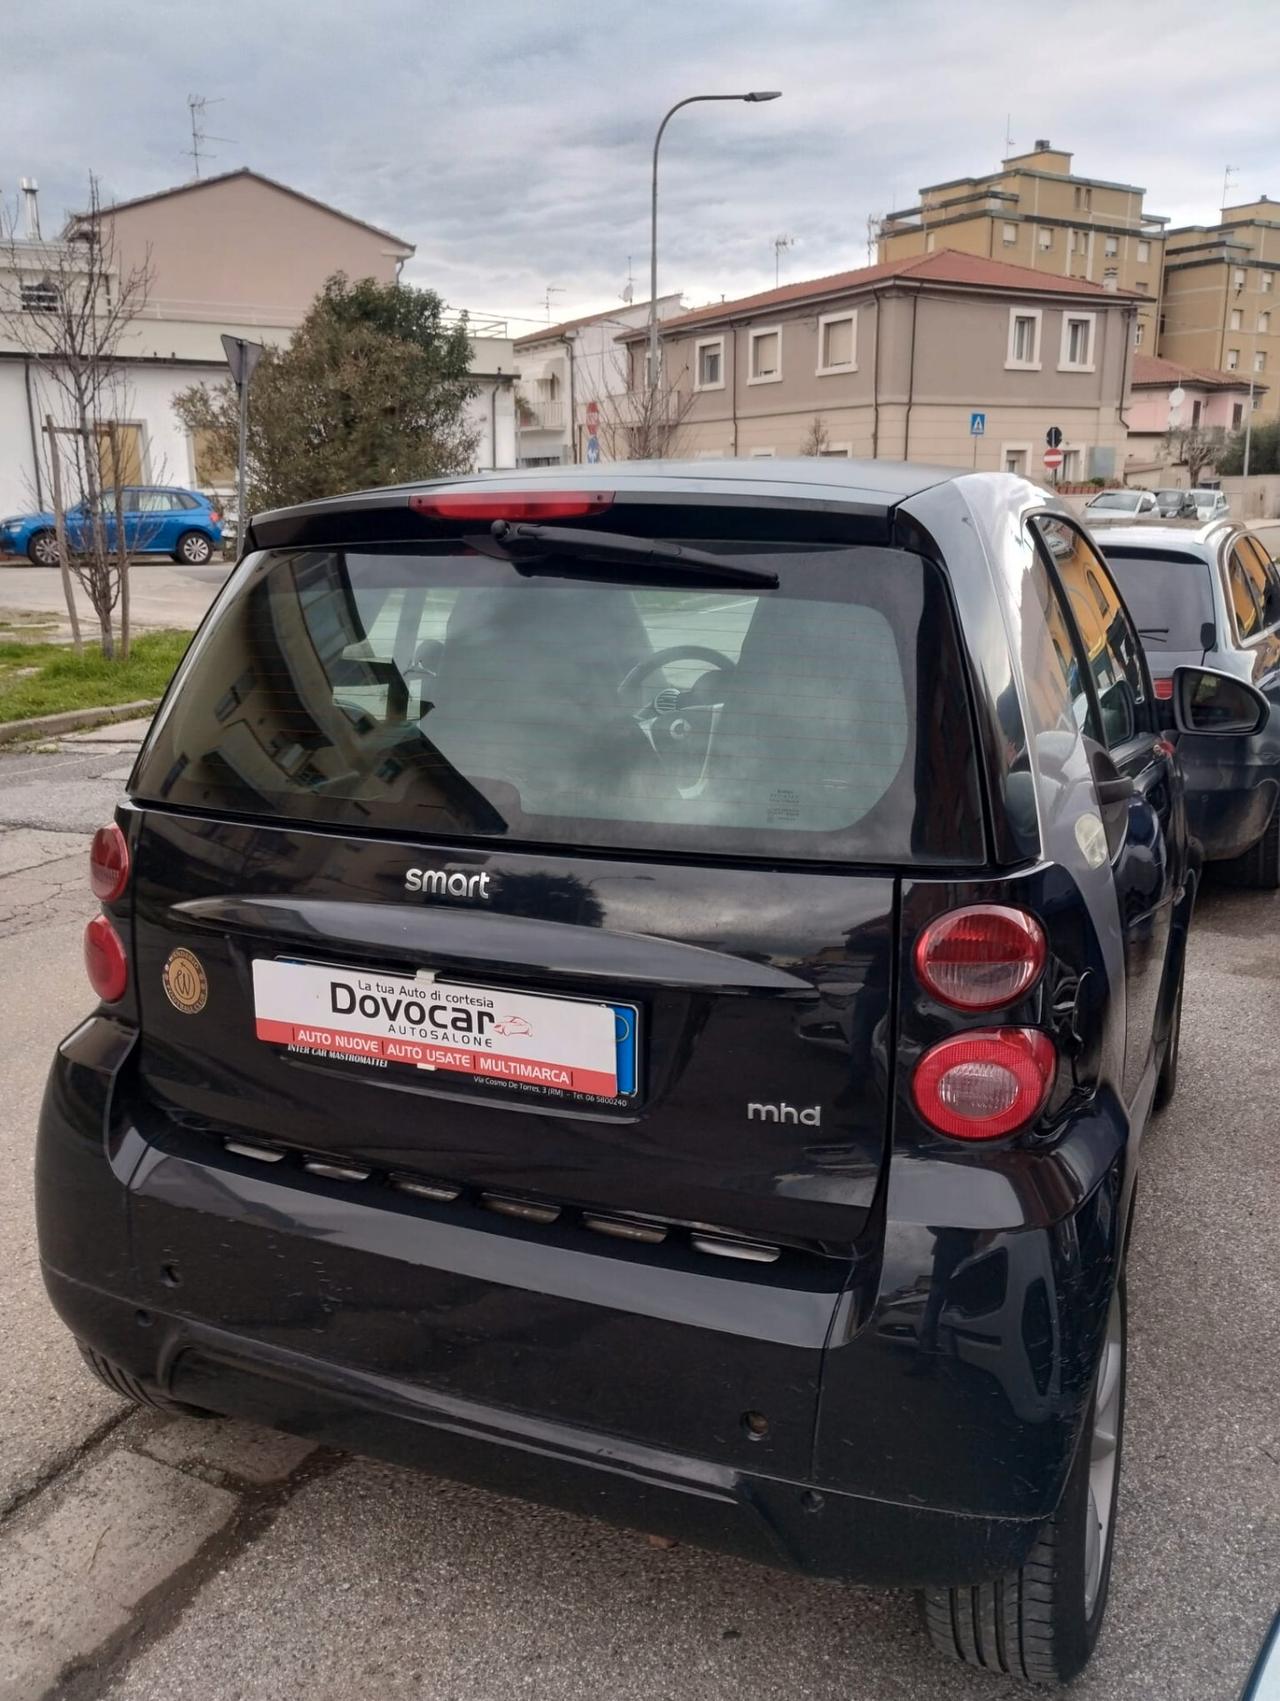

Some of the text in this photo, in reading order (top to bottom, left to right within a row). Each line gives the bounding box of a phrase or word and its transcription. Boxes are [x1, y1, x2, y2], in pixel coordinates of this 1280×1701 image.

[404, 868, 490, 899] smart
[330, 981, 495, 1035] Dovocar
[358, 980, 494, 1009] La tua Auto di cortesia
[388, 1023, 493, 1048] AUTOSALONE
[287, 1043, 388, 1068] INTER CAR MASTROMATTEI
[298, 1029, 570, 1085] AUTO NUOVE AUTO USATE MULTIMARCA
[473, 1075, 485, 1084] Via
[485, 1077, 508, 1088] Cosmo
[508, 1081, 519, 1089] De
[747, 1102, 821, 1126] mhd
